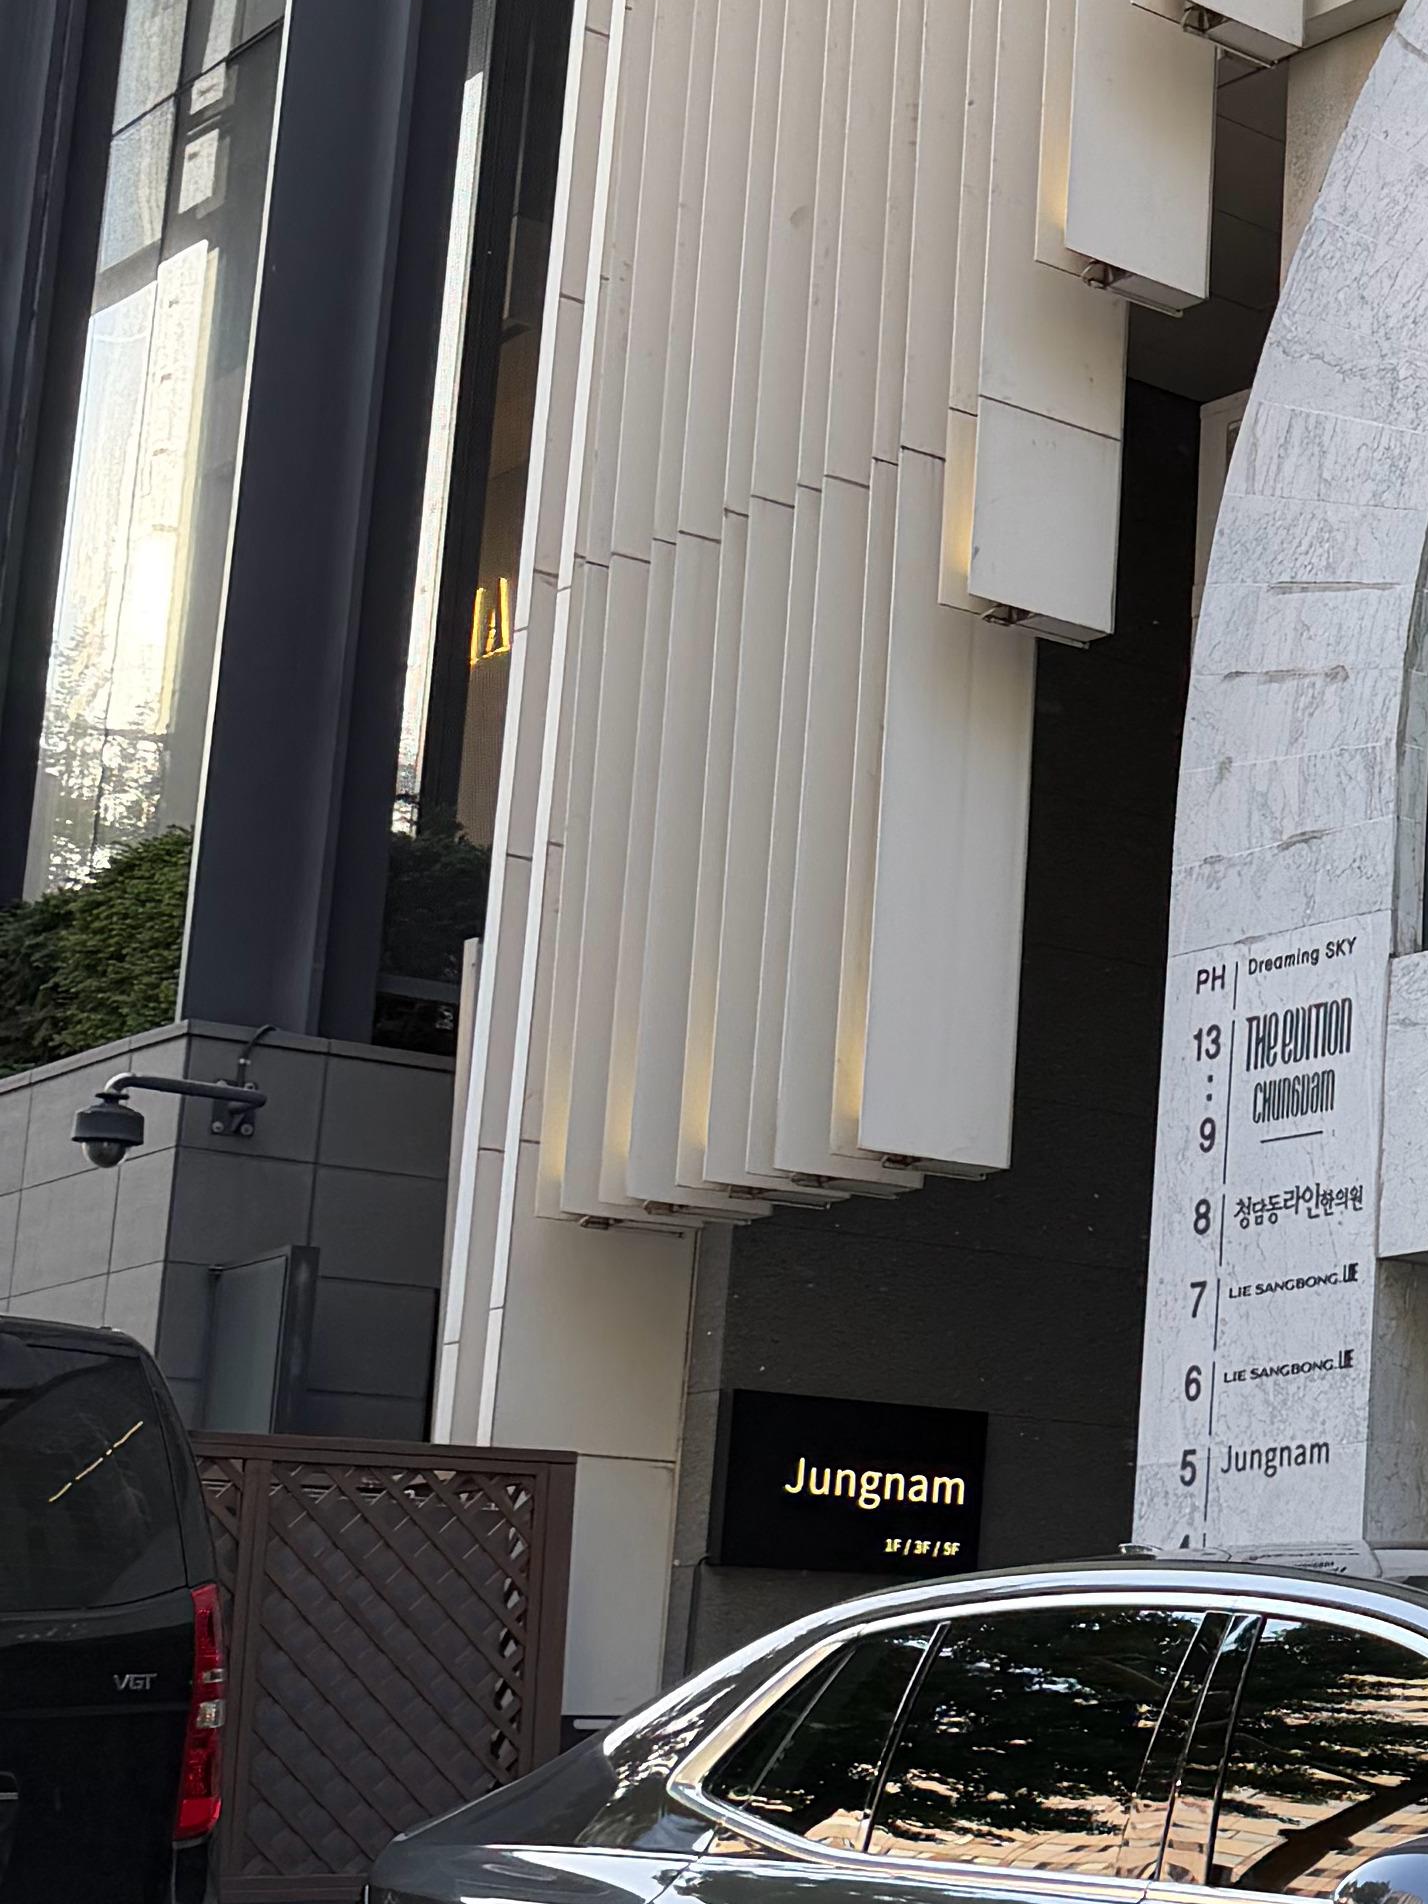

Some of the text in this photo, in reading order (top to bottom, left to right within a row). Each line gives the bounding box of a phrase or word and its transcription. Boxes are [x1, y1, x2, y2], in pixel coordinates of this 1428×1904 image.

[1195, 936, 1357, 995] PH Dreaming SKY
[1193, 1023, 1221, 1062] 13
[1200, 1117, 1216, 1153] 9
[1193, 1198, 1211, 1235] 8
[1190, 1280, 1207, 1318] 7
[1229, 1284, 1252, 1299] LIE
[1184, 1364, 1202, 1402] 6
[1223, 1369, 1246, 1383] LIE
[1179, 1441, 1330, 1487] 5 Jungnam
[785, 1457, 965, 1510] Jungnam
[113, 1673, 158, 1691] VGT
